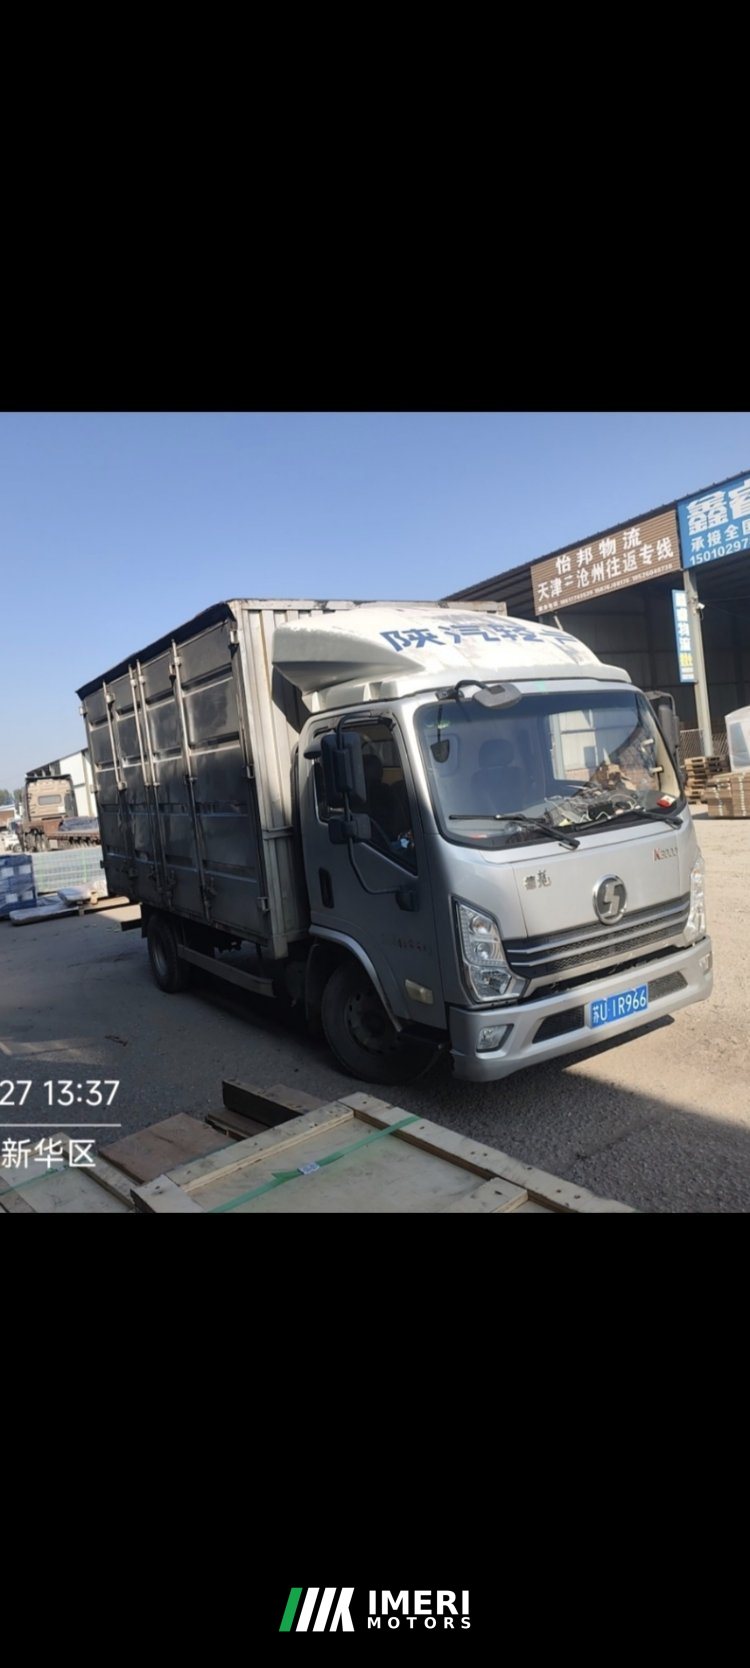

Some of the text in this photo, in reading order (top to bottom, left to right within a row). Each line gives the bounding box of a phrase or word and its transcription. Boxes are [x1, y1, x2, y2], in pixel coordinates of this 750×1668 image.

[555, 527, 642, 575] 怡邦物流
[689, 537, 750, 566] 15010297
